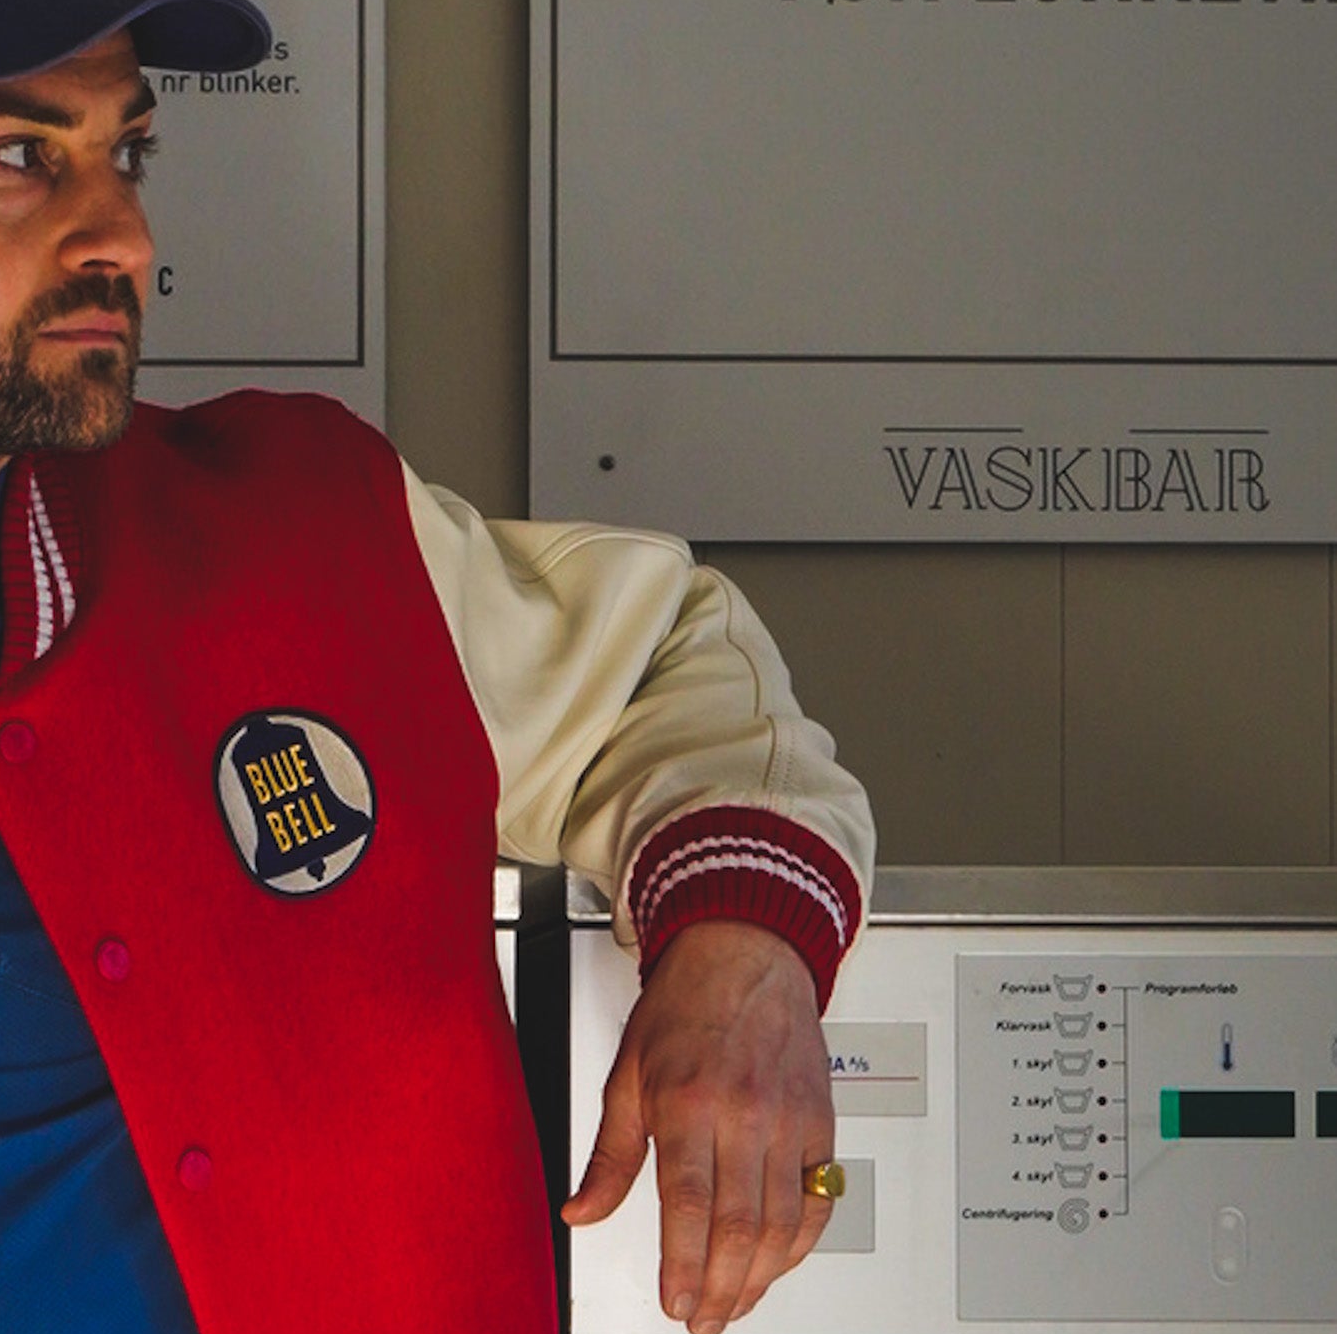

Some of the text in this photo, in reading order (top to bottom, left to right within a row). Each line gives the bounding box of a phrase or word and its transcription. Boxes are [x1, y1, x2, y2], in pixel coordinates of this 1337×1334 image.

[161, 73, 191, 93] nr
[199, 69, 301, 94] blinker.
[883, 445, 1271, 513] VASKBAR
[245, 744, 315, 805] BLUE
[265, 793, 336, 853] BELL
[999, 982, 1052, 995] Forvask
